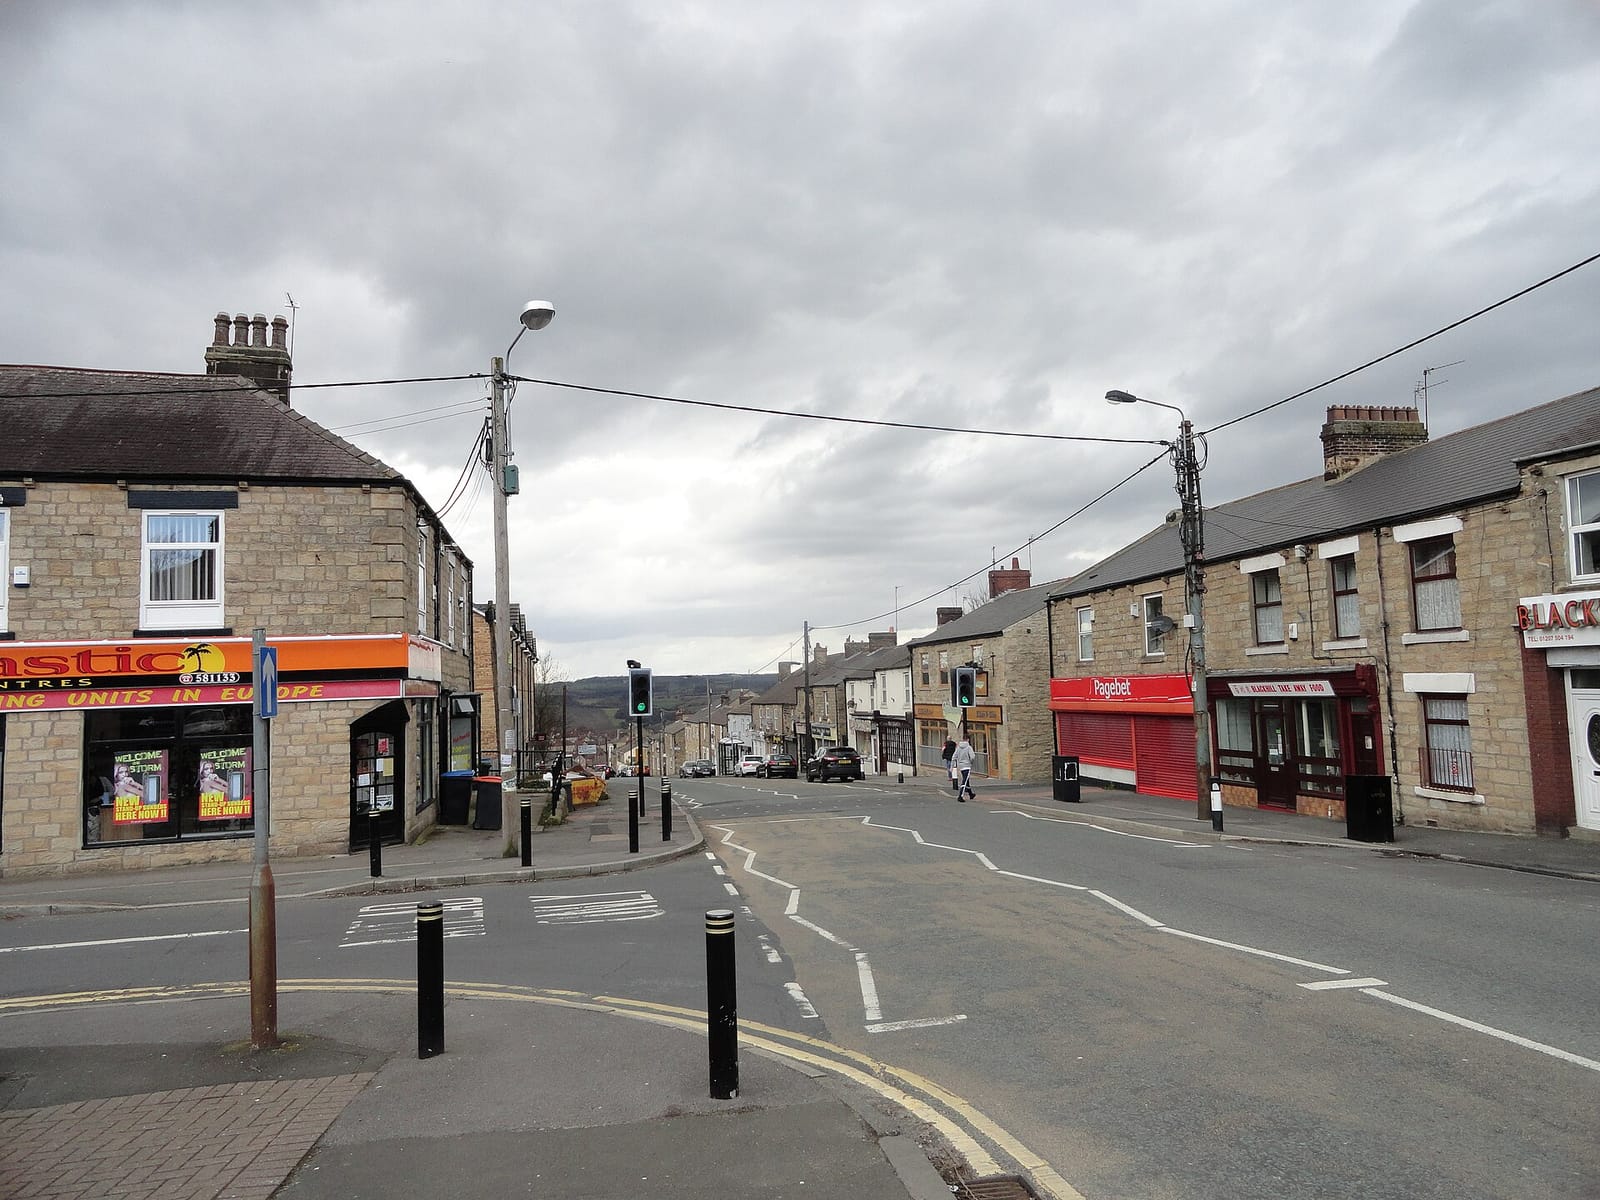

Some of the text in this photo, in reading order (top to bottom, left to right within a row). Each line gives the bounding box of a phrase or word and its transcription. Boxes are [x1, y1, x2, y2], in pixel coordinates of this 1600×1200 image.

[1516, 598, 1600, 631] BLACK
[195, 673, 237, 683] 581133
[1093, 677, 1132, 699] Pagebet
[1278, 684, 1292, 692] TAKE
[1309, 683, 1325, 692] FOOD
[68, 690, 154, 706] UNITS
[172, 688, 202, 703] IN
[221, 684, 325, 701] EUOPE
[115, 750, 163, 763] WELCOME
[200, 747, 247, 759] WELCOME
[130, 763, 162, 773] STORM
[215, 760, 246, 770] STORM
[116, 796, 140, 806] NEW
[202, 792, 225, 802] NEW
[115, 810, 137, 820] HERE
[139, 808, 160, 819] NOW
[202, 806, 222, 816] HERE
[223, 804, 243, 815] NOW
